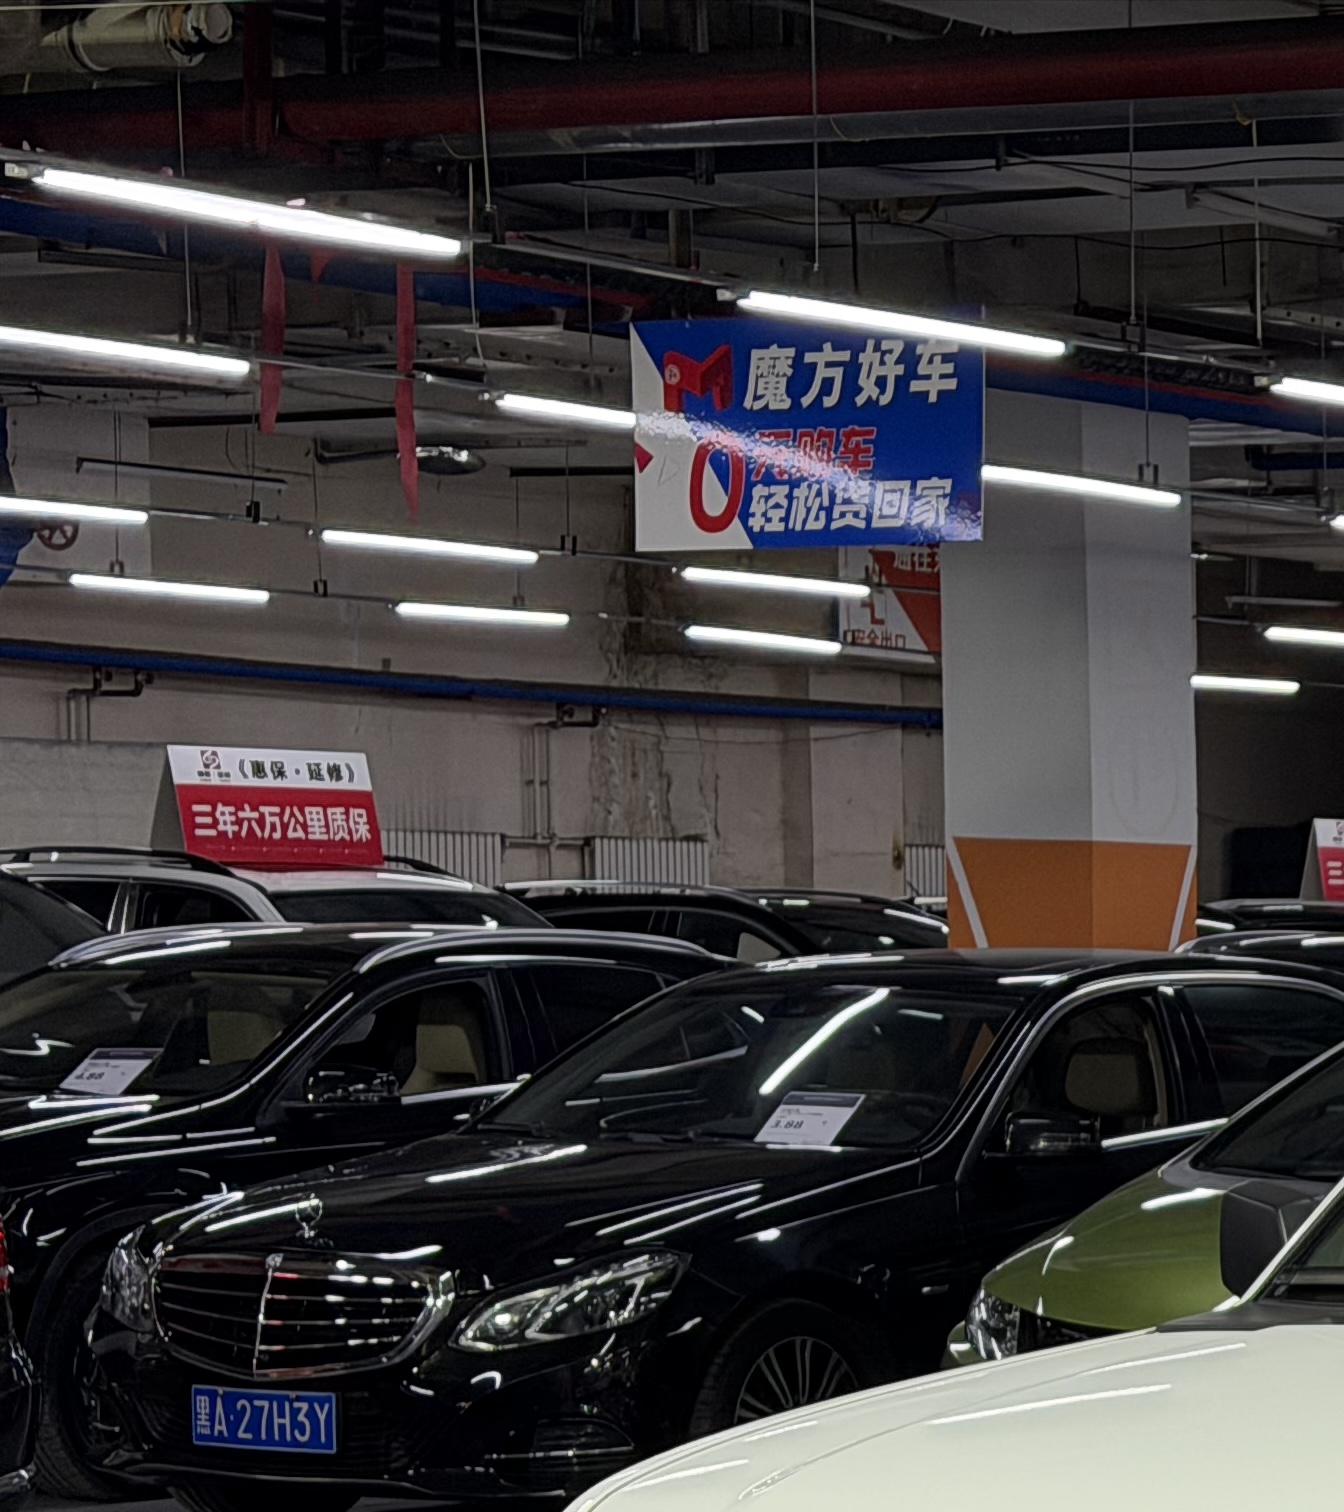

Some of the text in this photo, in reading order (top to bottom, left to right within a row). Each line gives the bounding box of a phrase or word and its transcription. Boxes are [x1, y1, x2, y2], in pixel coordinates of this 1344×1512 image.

[743, 338, 961, 412] 魔方好车
[191, 802, 372, 843] 三年六万公里质保
